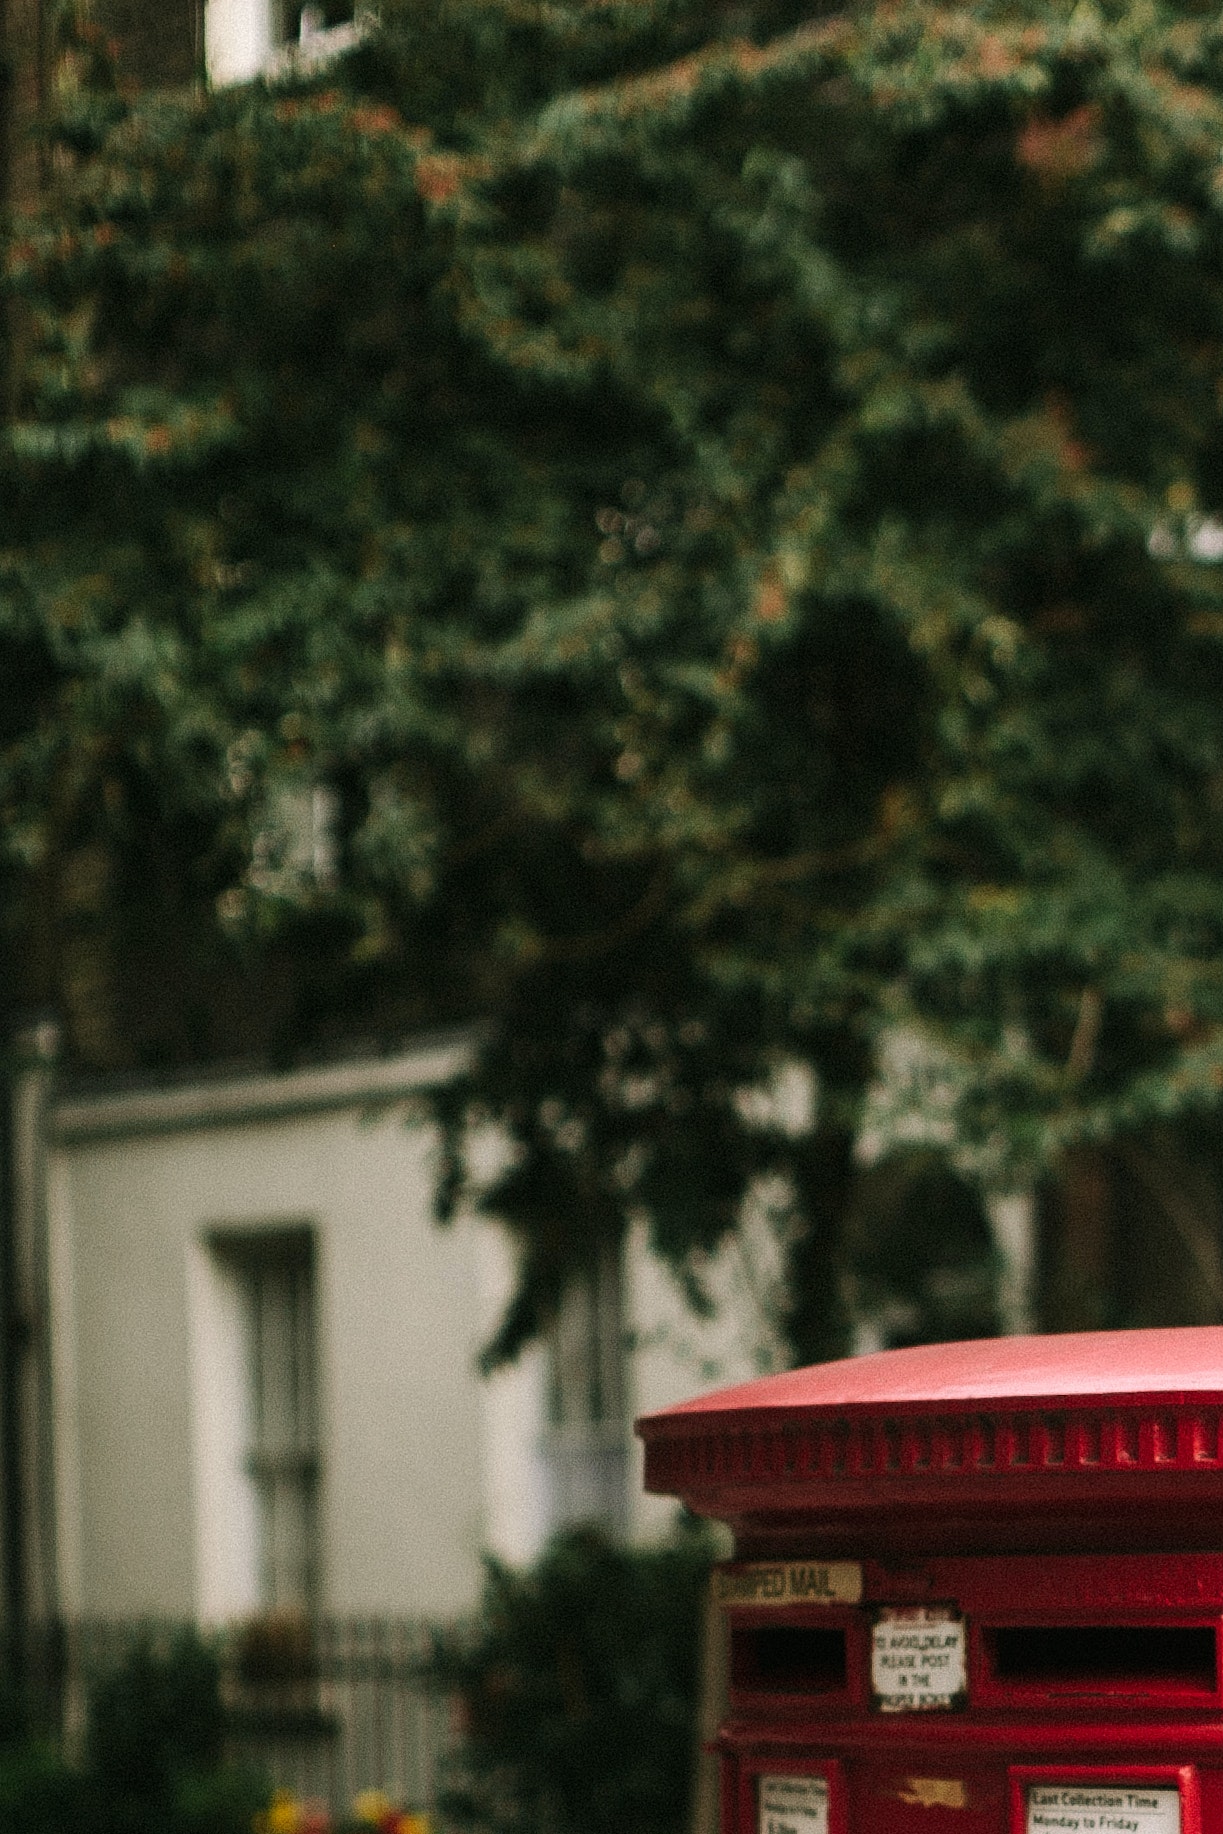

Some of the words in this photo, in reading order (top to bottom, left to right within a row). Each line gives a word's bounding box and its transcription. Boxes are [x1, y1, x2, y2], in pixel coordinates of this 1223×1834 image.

[789, 1566, 836, 1597] MAIL
[921, 1653, 950, 1669] POST
[1031, 1790, 1059, 1806] Last
[1061, 1791, 1123, 1807] Collection
[1127, 1793, 1158, 1809] Time
[1032, 1815, 1080, 1830] Monday
[1083, 1816, 1096, 1829] to
[1099, 1815, 1139, 1832] Friday
